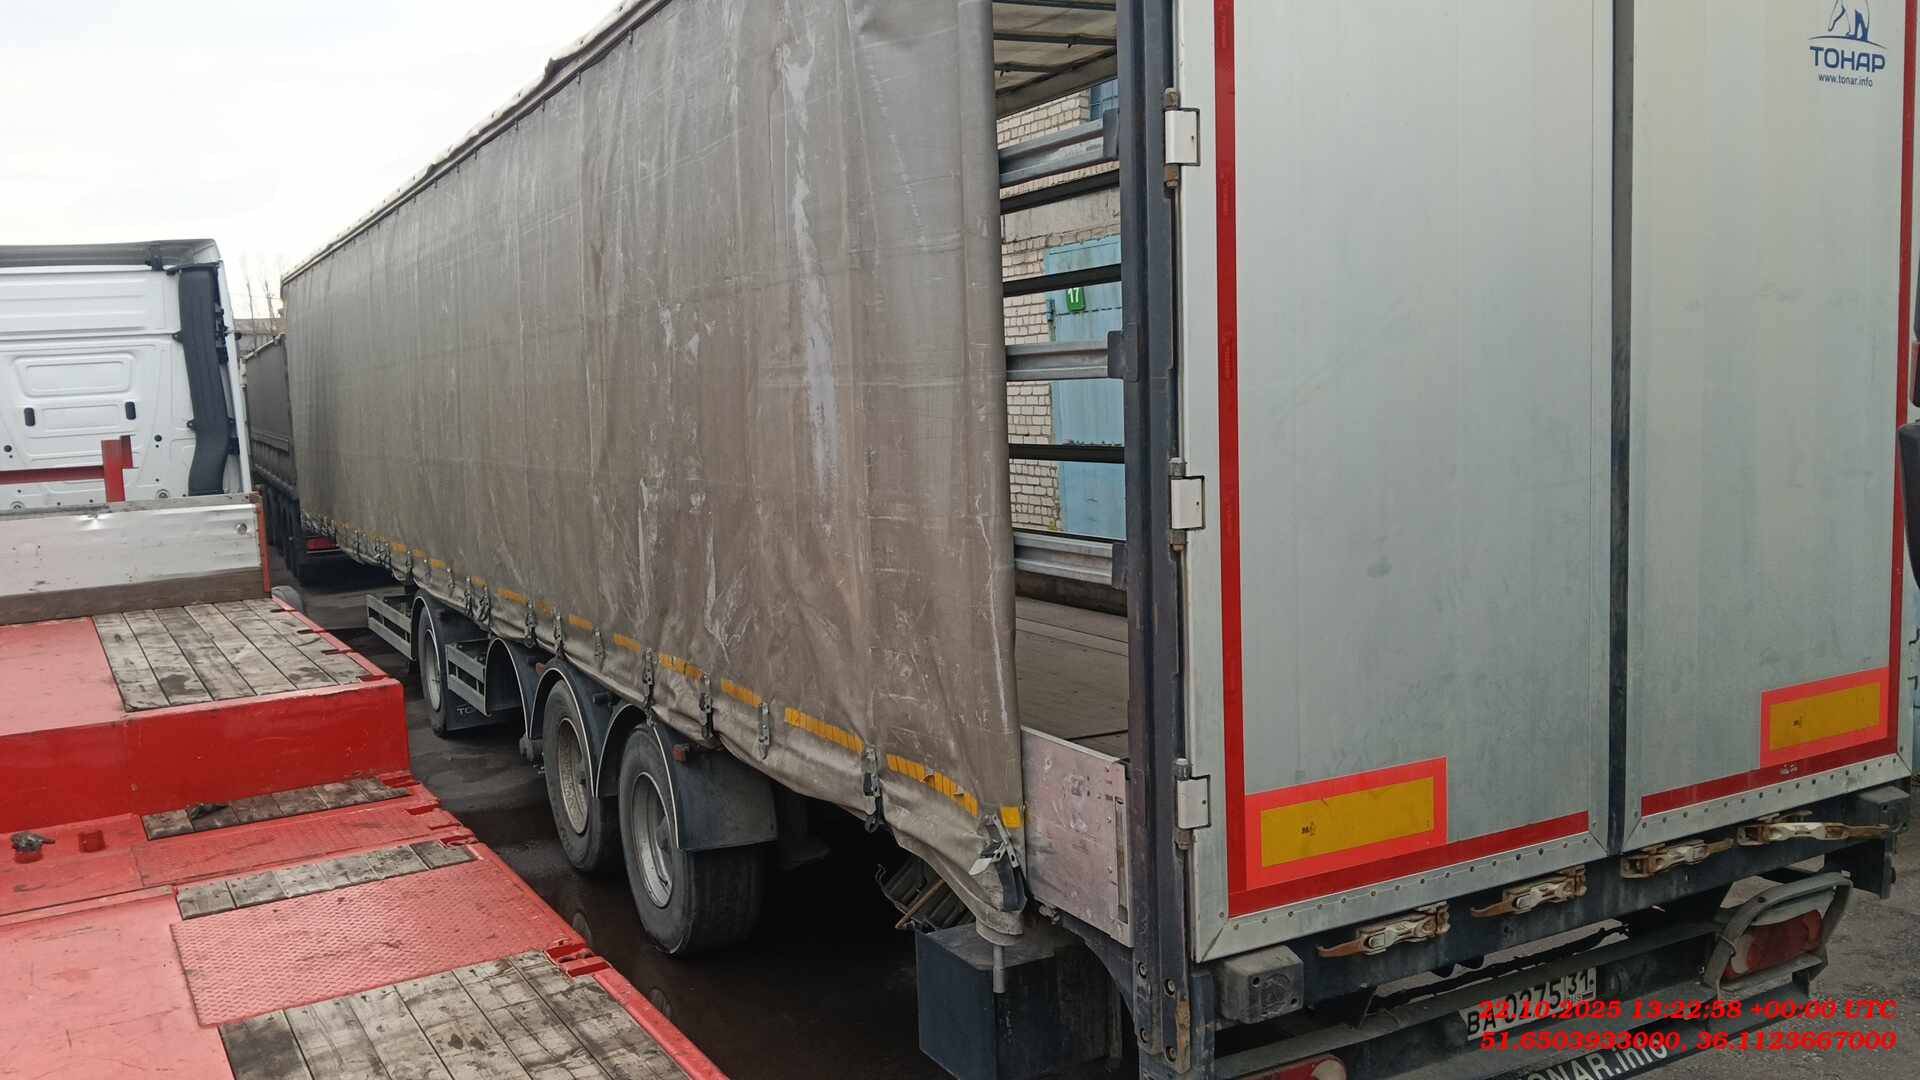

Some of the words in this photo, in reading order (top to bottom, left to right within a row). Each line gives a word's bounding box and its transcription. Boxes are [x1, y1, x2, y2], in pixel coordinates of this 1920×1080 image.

[1809, 46, 1886, 73] ТОНАР
[1818, 72, 1874, 88] www.tonar.info
[1067, 287, 1080, 304] 17
